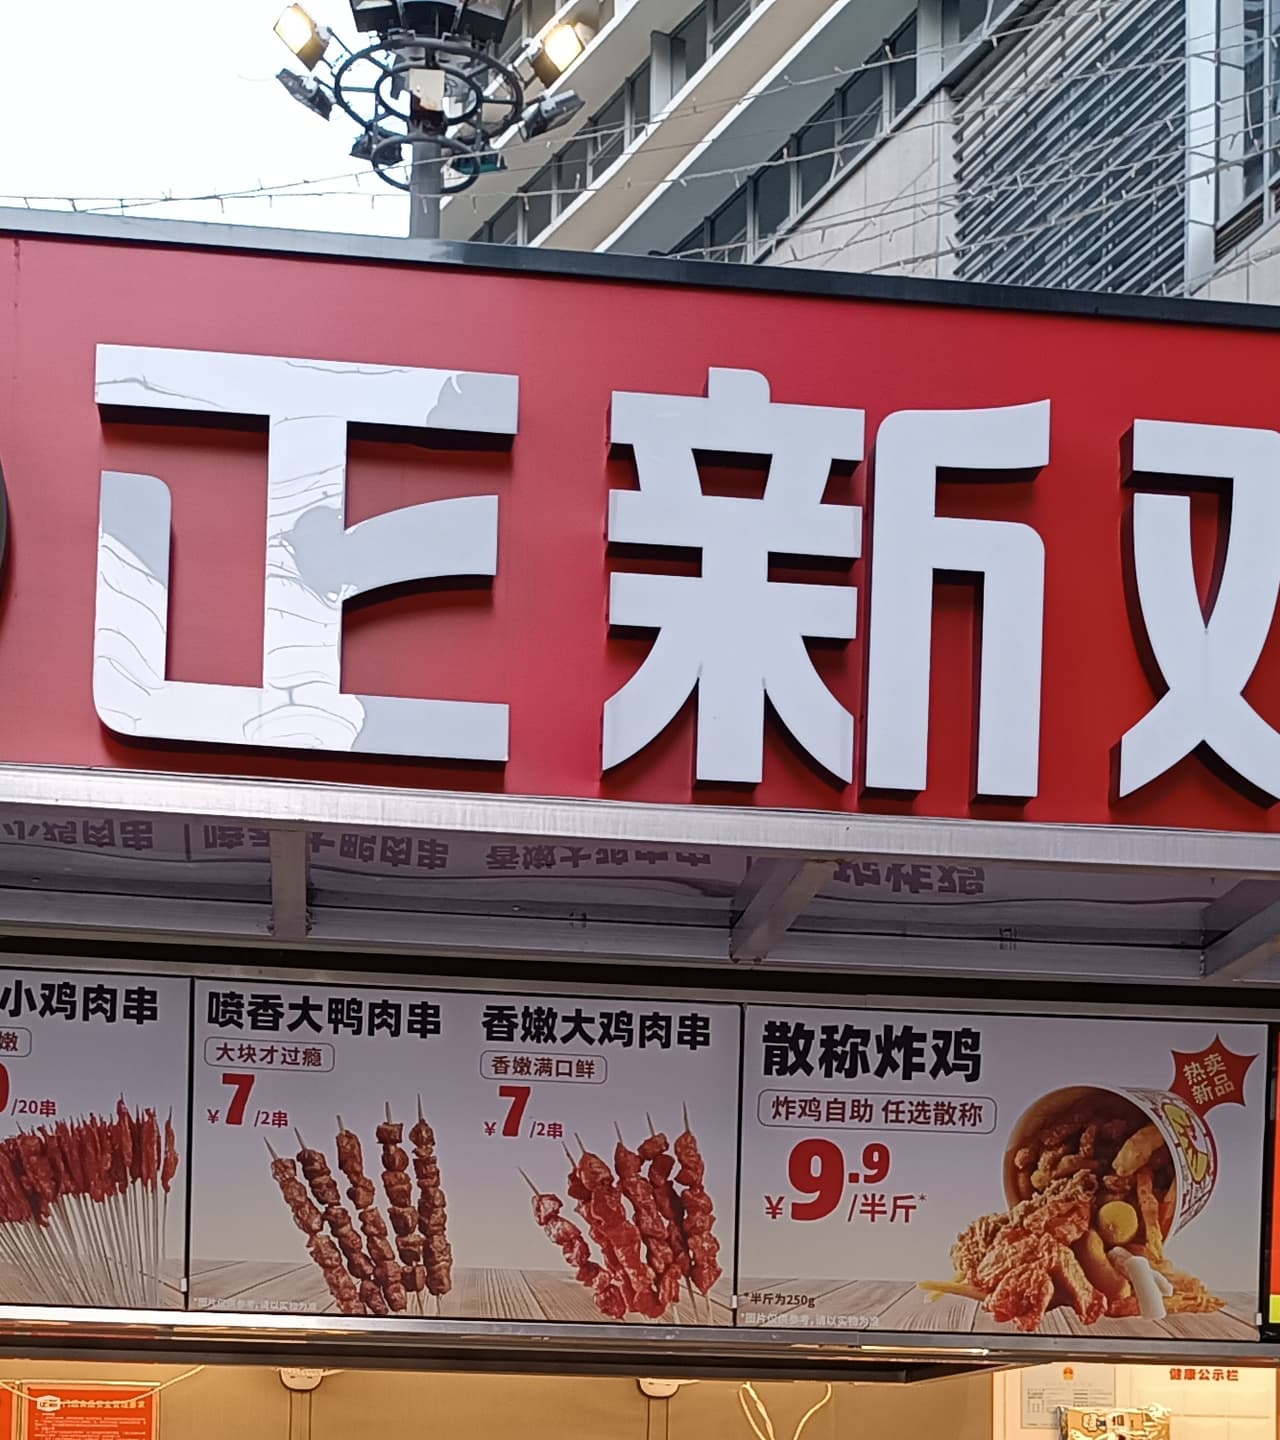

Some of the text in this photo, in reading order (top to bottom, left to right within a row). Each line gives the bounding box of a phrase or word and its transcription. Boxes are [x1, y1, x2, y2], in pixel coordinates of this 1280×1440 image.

[207, 991, 442, 1039] 喷香大鸭肉串
[481, 1004, 712, 1051] 香嫩大鸡肉串
[215, 1041, 323, 1068] 大块才过瘾
[491, 1055, 596, 1079] 香嫩满口鲜
[762, 1019, 982, 1083] 散称炸鸡
[1182, 1053, 1228, 1086] 热卖
[1190, 1073, 1236, 1106] 新品
[771, 1096, 984, 1129] 炸鸡自助 任选散称
[1169, 1367, 1239, 1381] 健康公示栏
